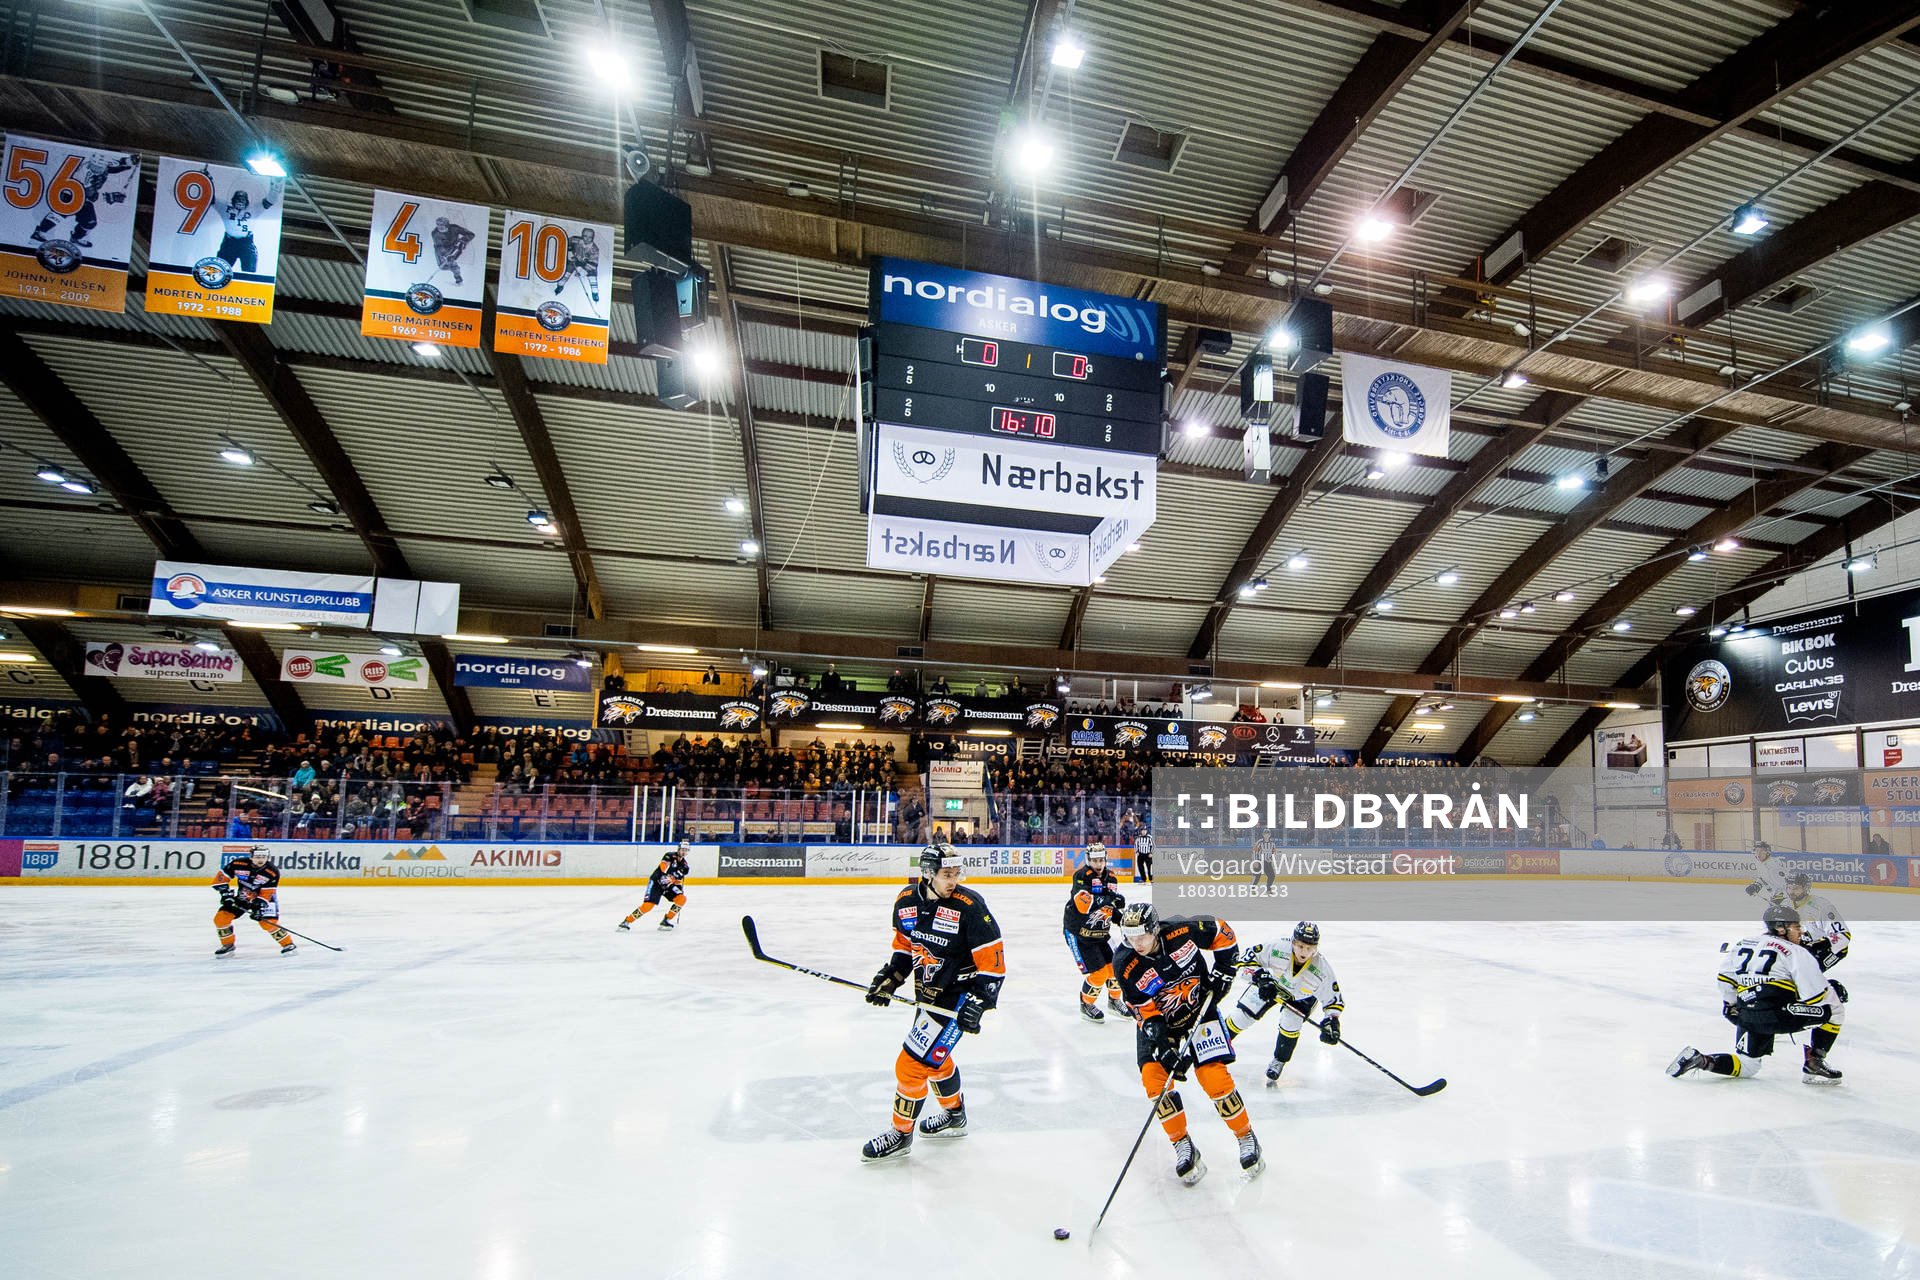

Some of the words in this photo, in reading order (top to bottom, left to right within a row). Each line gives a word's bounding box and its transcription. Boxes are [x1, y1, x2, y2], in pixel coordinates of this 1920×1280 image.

[3, 146, 86, 216] 56
[174, 170, 215, 235] 9
[382, 202, 422, 264] 4
[508, 221, 568, 283] 10
[4, 269, 56, 287] JOHNNY
[60, 276, 107, 292] NILSEN
[18, 283, 47, 297] 1991
[60, 290, 90, 303] 2009
[153, 287, 202, 301] MORTEN
[205, 292, 266, 306] JOHANSEN
[177, 301, 204, 313] 1972
[215, 305, 242, 316] 1988
[883, 274, 1107, 333] nordialog
[371, 312, 402, 324] THOR
[405, 316, 473, 332] MARTINSEN
[978, 317, 1018, 333] ASKER
[392, 325, 417, 337] 1969
[428, 329, 451, 340] 1981
[500, 328, 542, 341] MORTEN
[545, 334, 605, 349] SETHERENG
[523, 342, 548, 354] 1972
[557, 346, 581, 357] 1986
[956, 344, 963, 354] H
[983, 343, 997, 364] 0
[907, 365, 914, 375] 2
[1072, 356, 1086, 377] 0
[1086, 364, 1094, 373] G
[906, 375, 913, 385] 5
[985, 383, 995, 392] 10
[905, 398, 913, 408] 2
[1054, 393, 1065, 402] 10
[1106, 394, 1113, 403] 2
[904, 408, 911, 417] 5
[1105, 403, 1112, 412] 5
[1001, 410, 1054, 435] 16:10
[1105, 425, 1112, 434] 2
[1104, 433, 1111, 443] 5
[982, 452, 1144, 501] Nærbakst
[212, 588, 252, 600] ASKER
[255, 591, 361, 607] KUNSTLØPKLUBB
[1772, 615, 1845, 637] Dressmann
[290, 663, 311, 672] RIIS
[456, 662, 566, 680] nordialog
[1785, 655, 1834, 675] Cubus
[144, 668, 224, 679] superselma.no
[365, 667, 385, 676] RIIS
[369, 687, 391, 699] D
[770, 690, 788, 700] FRISK
[789, 690, 809, 701] ASKER
[535, 694, 551, 708] E
[603, 695, 623, 705] FRISK
[623, 695, 645, 706] ASKER
[720, 701, 739, 711] FRISK
[739, 701, 760, 712] ASKER
[880, 696, 896, 705] FRISK
[897, 696, 916, 706] ASKER
[926, 698, 943, 708] FRISK
[646, 706, 717, 719] Dressmann
[811, 701, 876, 714] Dressmann
[1026, 704, 1042, 712] FRISK
[964, 709, 1024, 720] Dressmann
[1114, 721, 1131, 730] FRISK
[1236, 729, 1252, 738] KIA
[1758, 746, 1800, 756] VAKTMESTER
[1796, 810, 1870, 824] SpareBank
[1876, 809, 1886, 819] 1
[25, 853, 55, 866] 1881
[76, 843, 206, 871] 1881.no
[721, 856, 803, 868] Dressmann
[1464, 857, 1504, 867] astrofarm
[1525, 858, 1558, 867] EXTRA
[990, 866, 1028, 876] TANDBERG
[1029, 866, 1062, 876] EIENDOM
[1876, 863, 1888, 880] 1
[1807, 872, 1866, 883] STLANDET
[1736, 947, 1778, 975] 77
[1196, 1036, 1225, 1052] ARKEL
